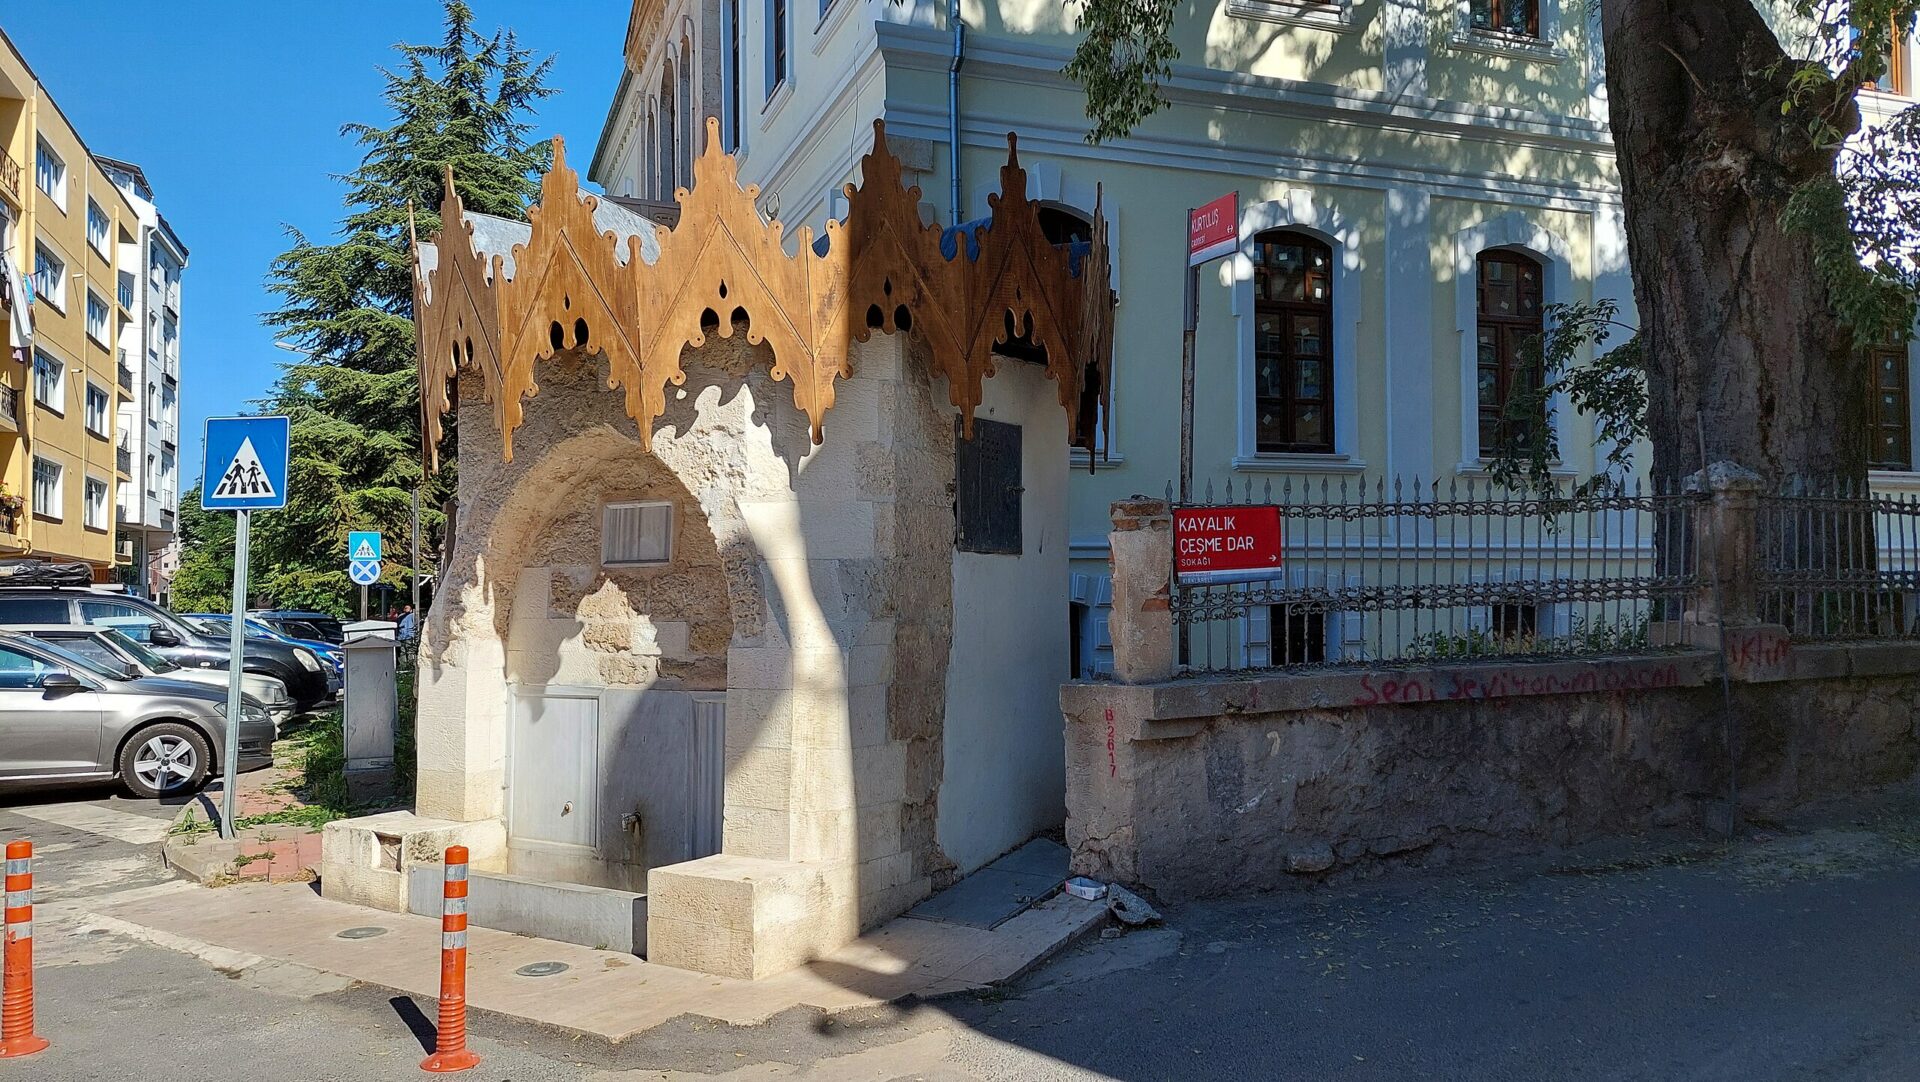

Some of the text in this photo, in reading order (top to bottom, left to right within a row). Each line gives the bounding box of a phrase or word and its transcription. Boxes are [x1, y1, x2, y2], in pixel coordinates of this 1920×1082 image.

[1191, 208, 1219, 234] KURTULUŞ
[1178, 516, 1236, 532] KAYALIK
[1180, 536, 1254, 555] ÇEŞME DAR
[1181, 556, 1211, 567] SOKAĞI
